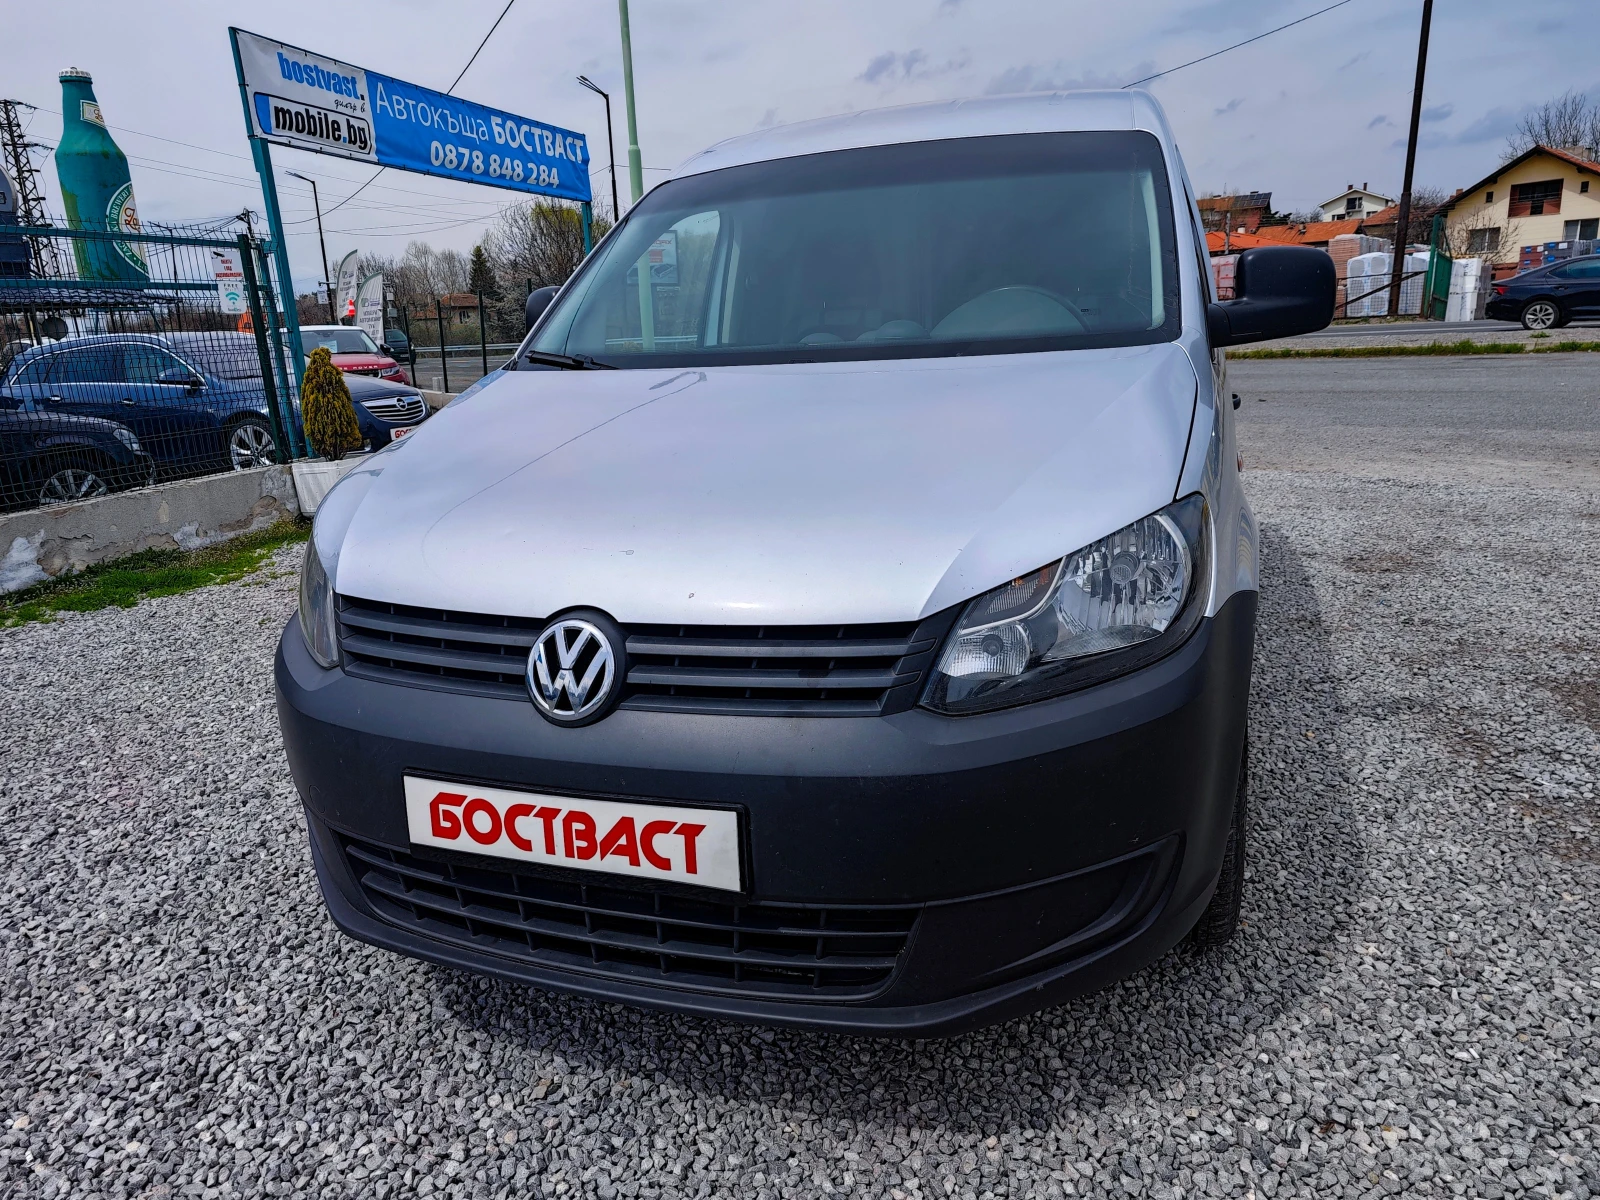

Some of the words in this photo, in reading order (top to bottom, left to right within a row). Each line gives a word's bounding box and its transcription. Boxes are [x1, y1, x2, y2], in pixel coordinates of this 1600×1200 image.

[277, 52, 365, 101] bostvast.
[274, 105, 368, 150] mobile.bg
[491, 115, 583, 164] БОСТВАСТ
[430, 140, 484, 174] 0878
[489, 154, 524, 182] 848
[527, 163, 559, 188] 284
[429, 791, 706, 875] БОСТВАСТ
